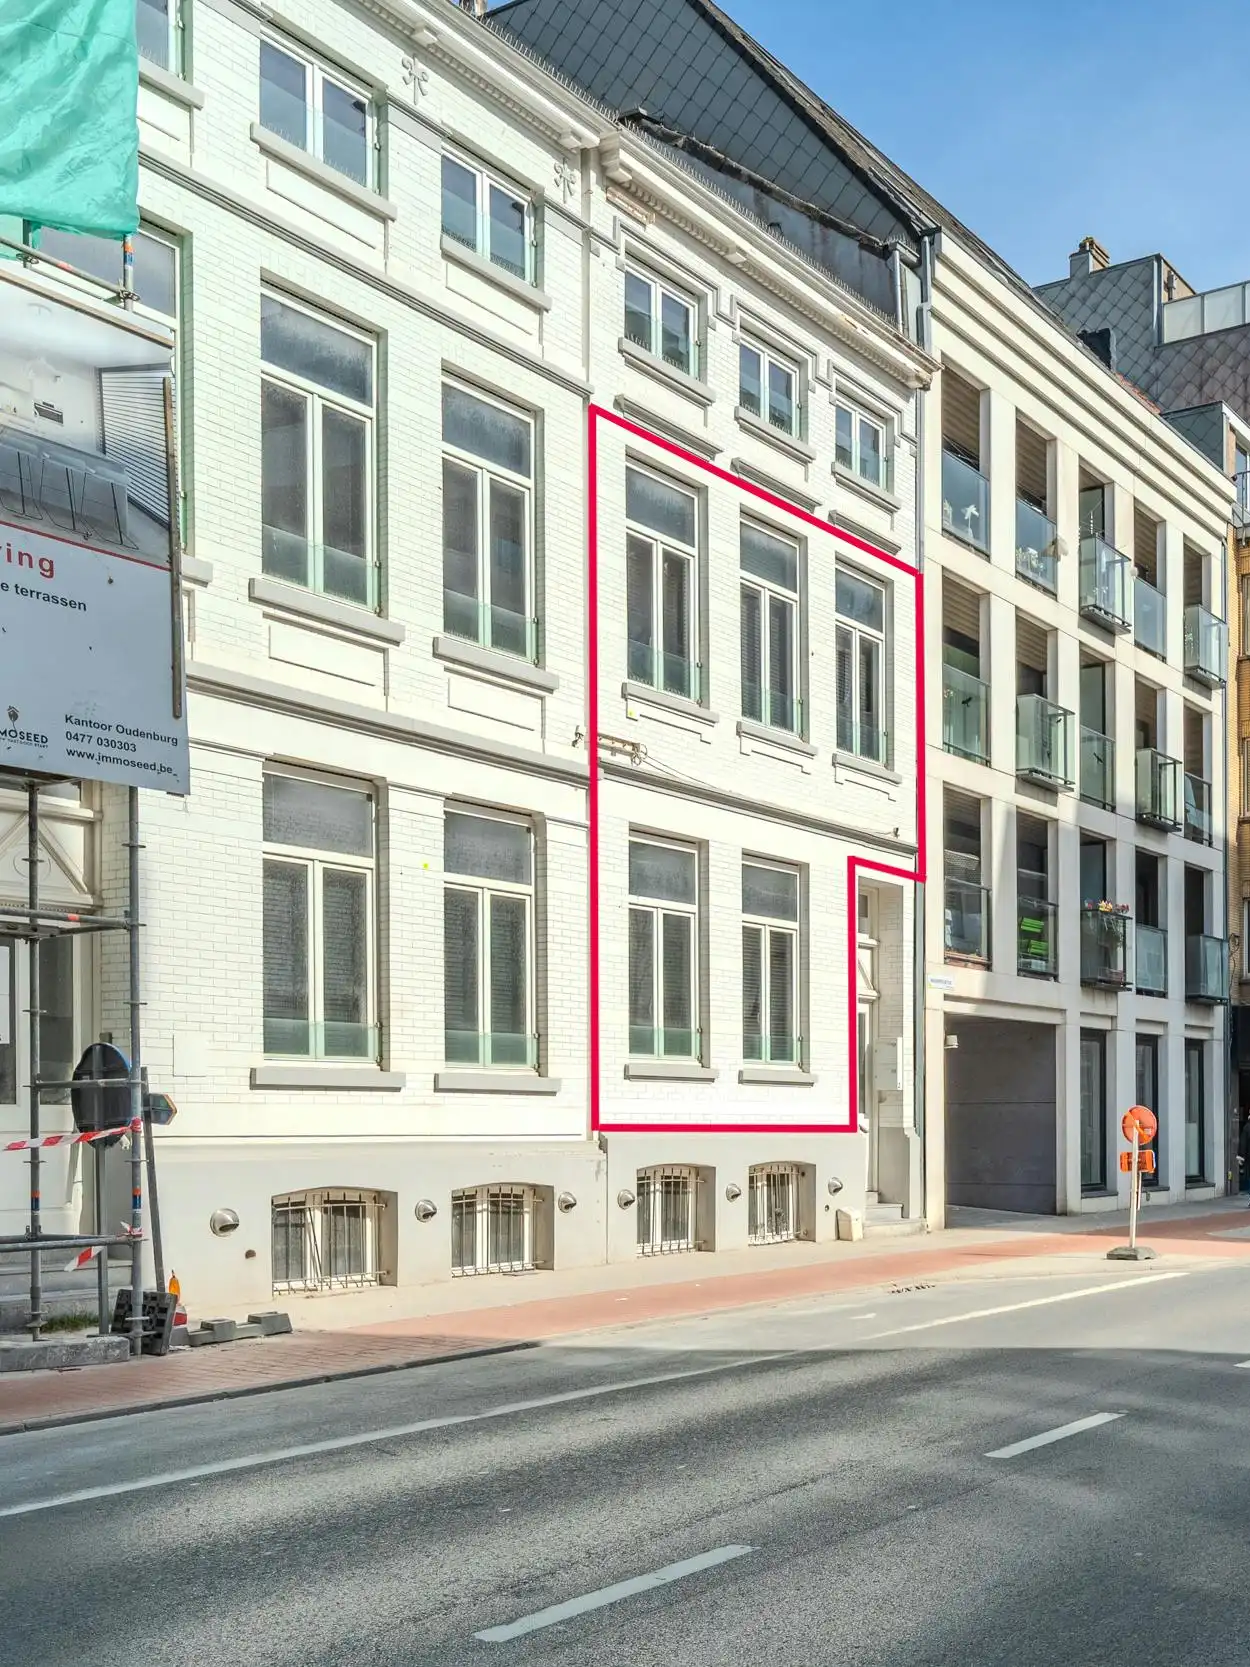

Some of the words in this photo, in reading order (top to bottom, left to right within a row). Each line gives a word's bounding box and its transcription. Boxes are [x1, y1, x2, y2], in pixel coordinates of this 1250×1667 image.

[0, 542, 54, 579] ing
[14, 583, 87, 612] terrassen
[65, 714, 112, 732] Kantoor
[116, 724, 178, 747] Oudenburg
[65, 731, 93, 744] 0477
[97, 737, 137, 752] 030303
[66, 748, 173, 774] www.immoseed.be
